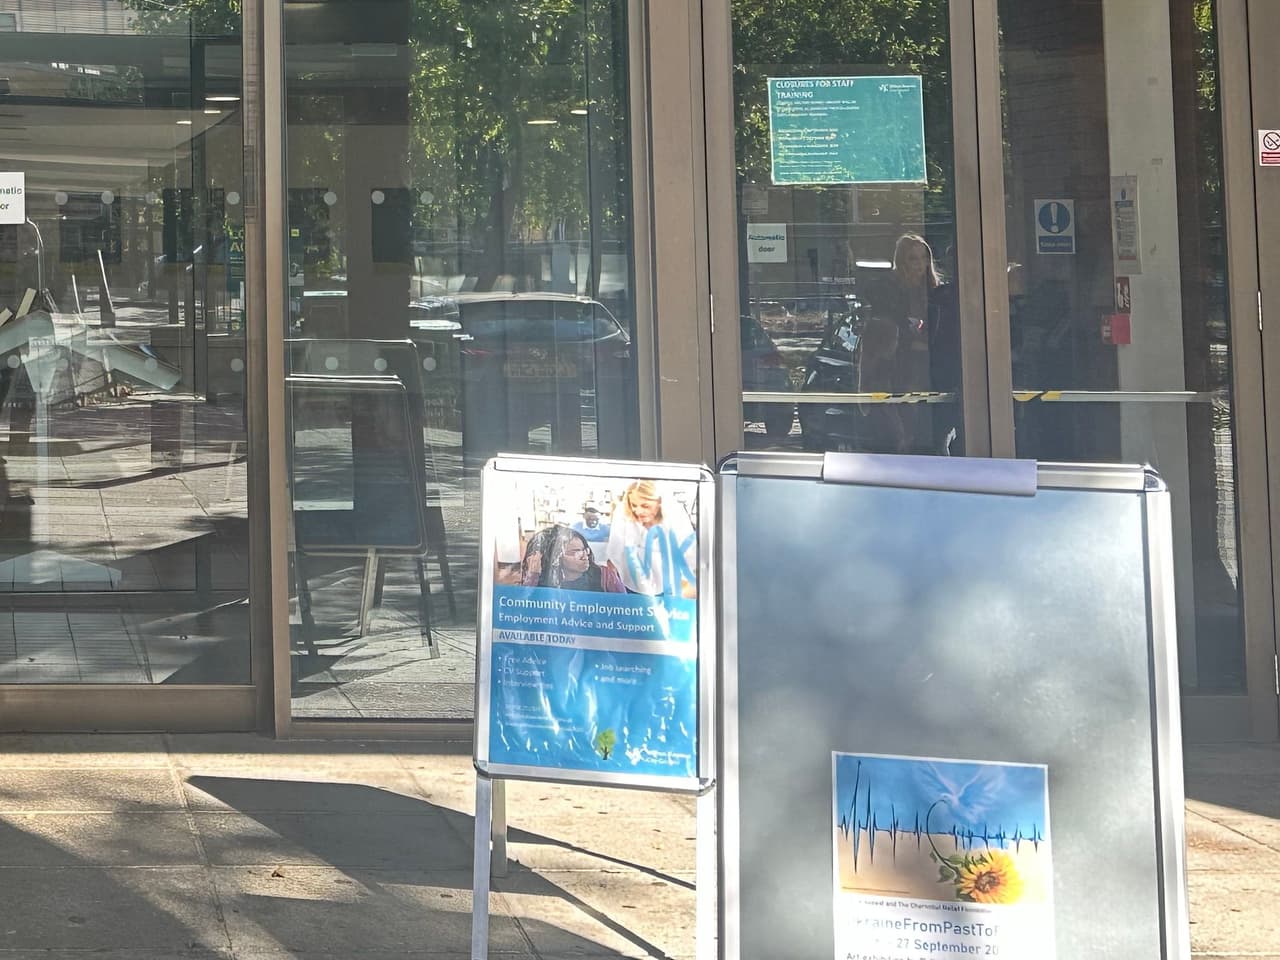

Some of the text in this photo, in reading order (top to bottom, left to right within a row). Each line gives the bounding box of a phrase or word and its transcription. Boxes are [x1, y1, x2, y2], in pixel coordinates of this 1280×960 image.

[832, 79, 855, 87] STAFF
[776, 91, 814, 99] TRAINING
[499, 595, 566, 613] Community
[569, 601, 644, 618] Employment
[498, 612, 655, 634] Employment Advice and Support
[498, 631, 576, 645] AVAILABLE TODAY
[914, 939, 981, 954] September
